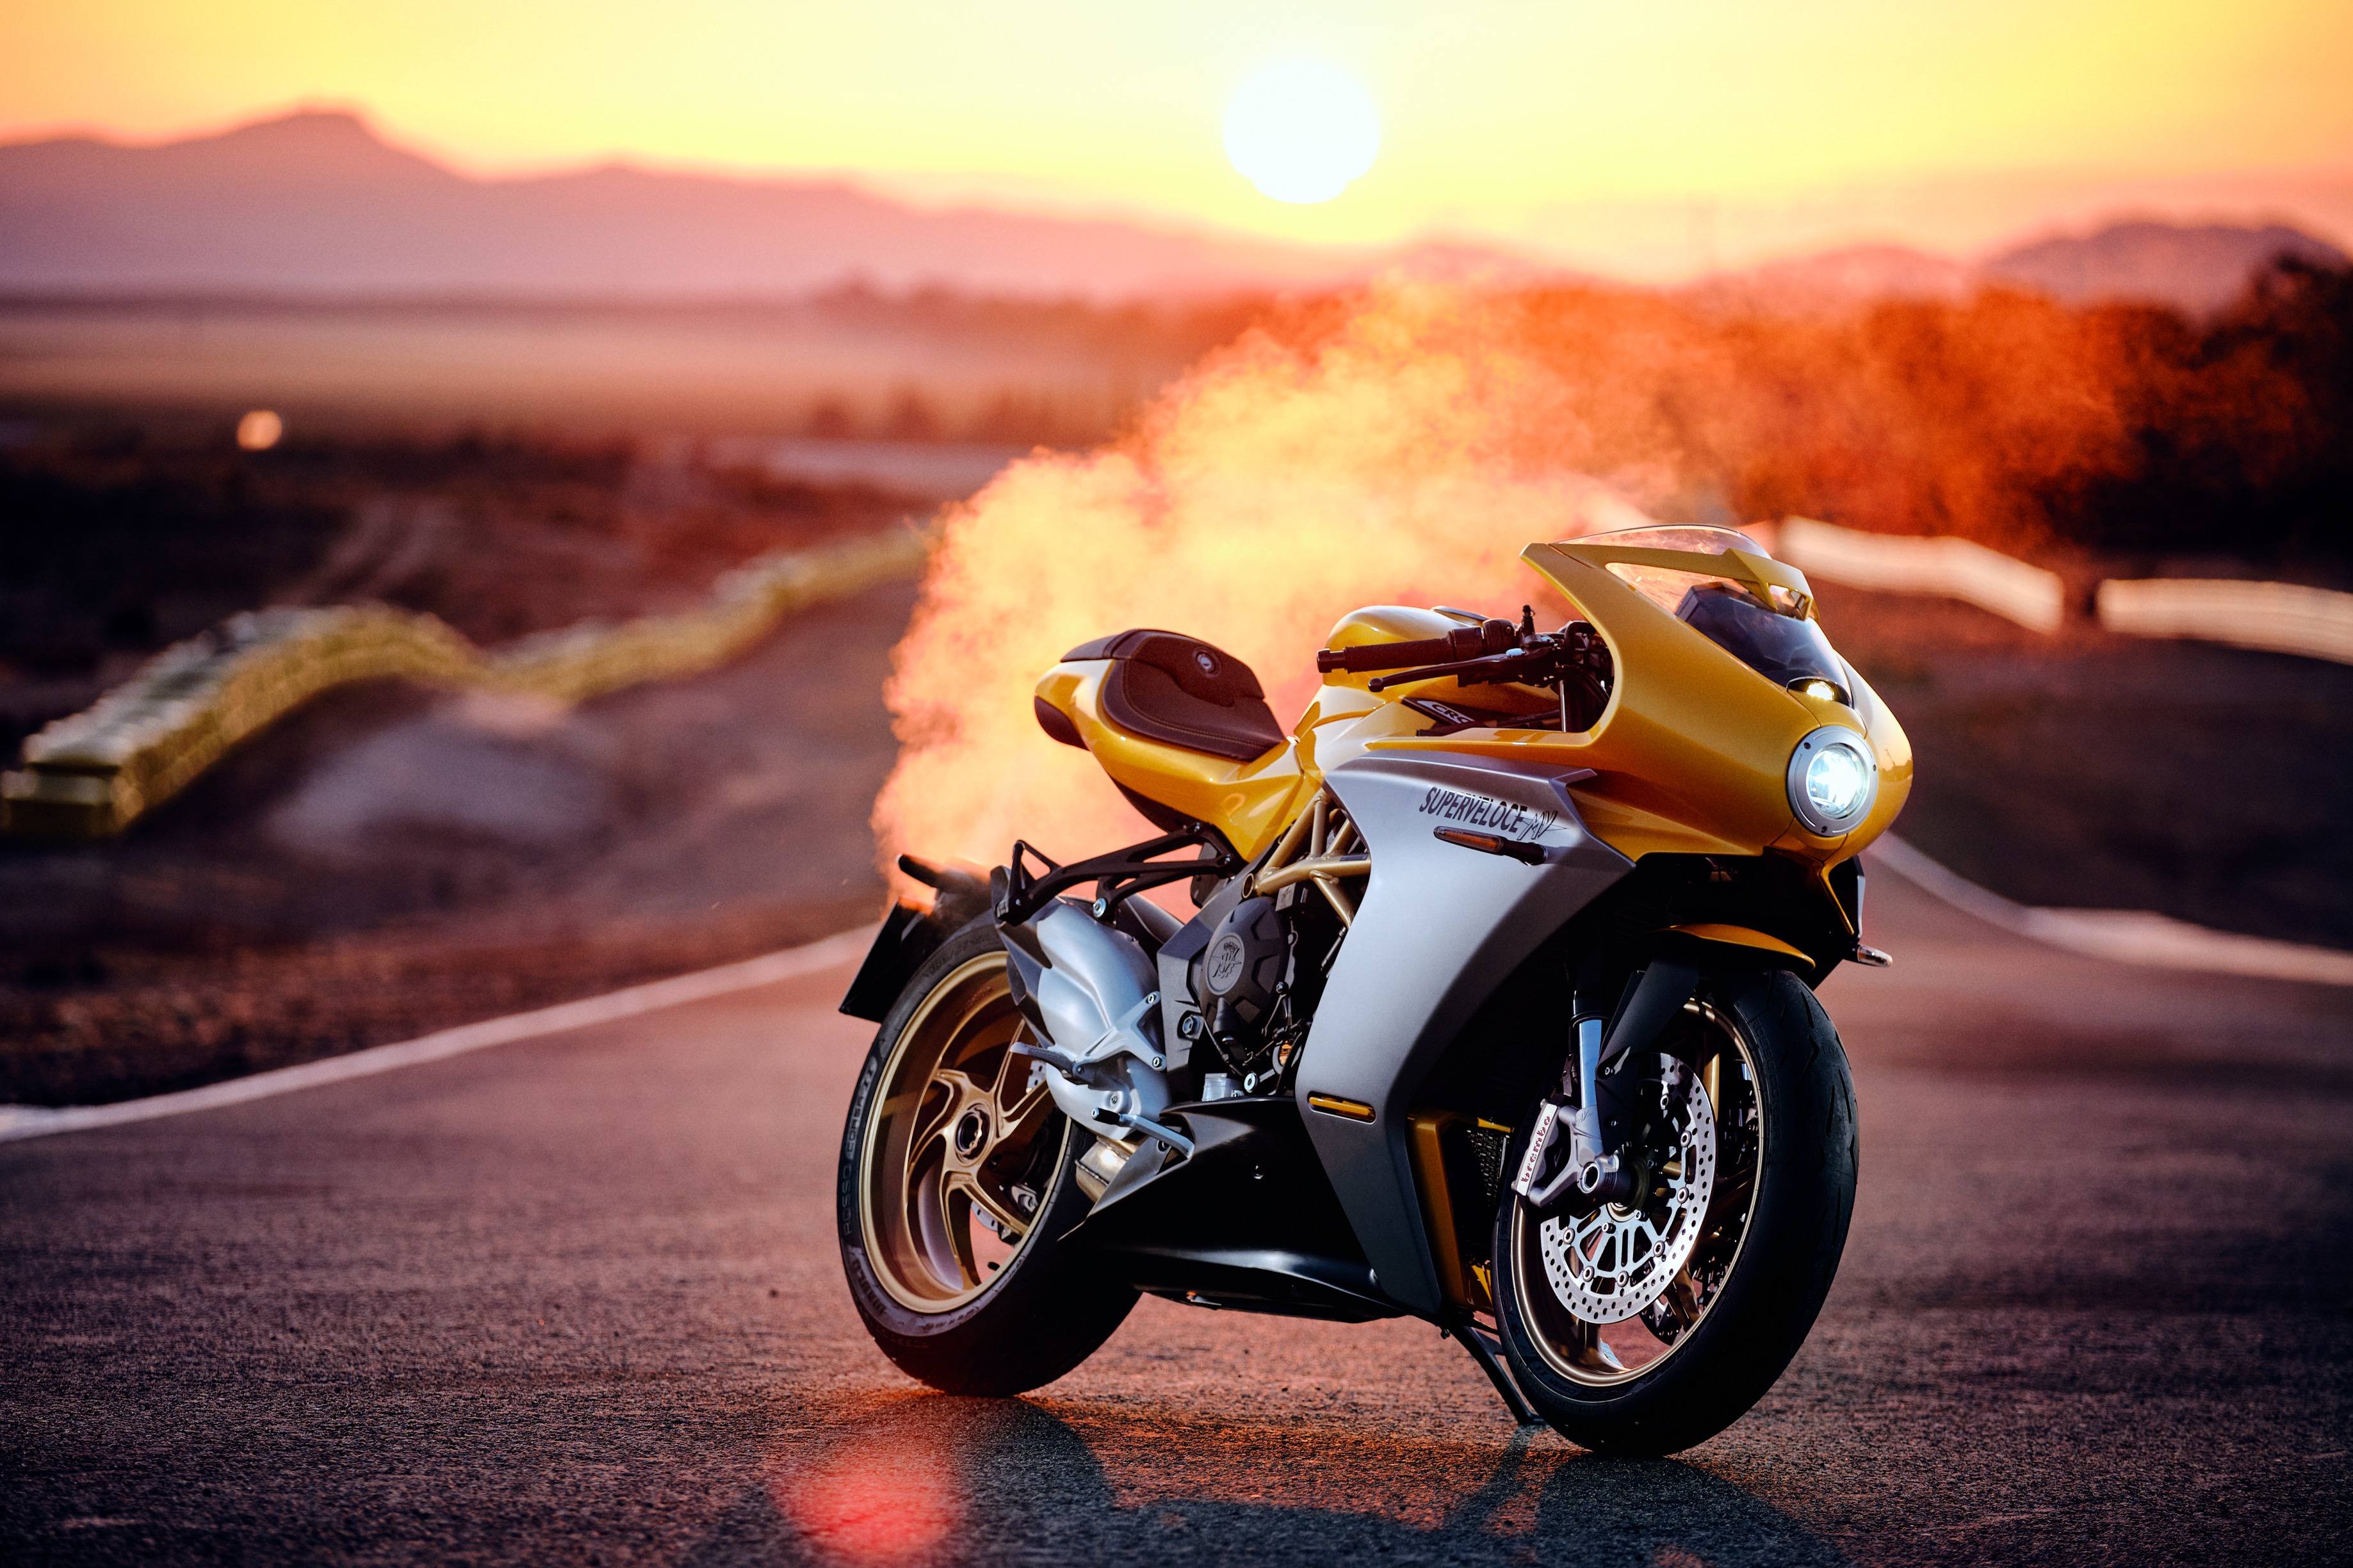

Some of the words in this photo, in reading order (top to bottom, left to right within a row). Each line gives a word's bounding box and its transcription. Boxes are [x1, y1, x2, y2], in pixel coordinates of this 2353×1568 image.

[1419, 786, 1528, 833] SUPERVELOCE
[846, 1095, 864, 1152] CORSA
[1520, 1116, 1551, 1182] brembo
[841, 1163, 852, 1236] ROSSO
